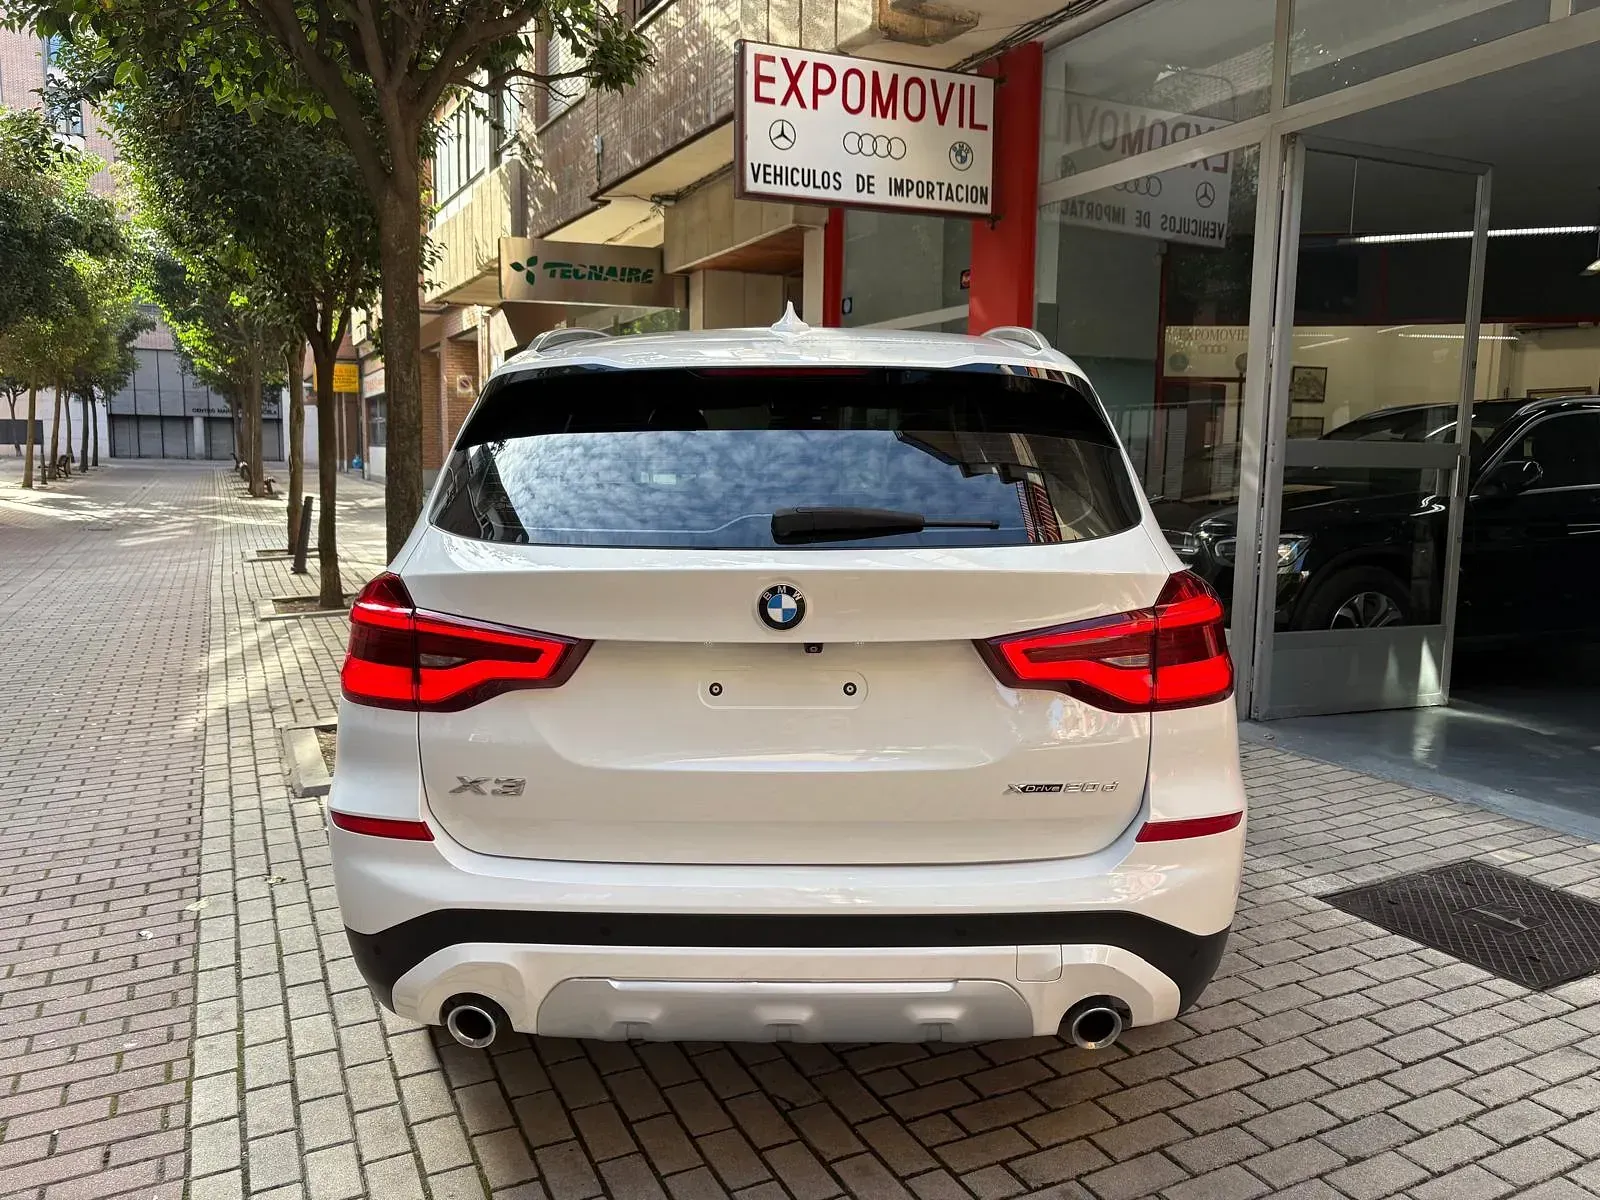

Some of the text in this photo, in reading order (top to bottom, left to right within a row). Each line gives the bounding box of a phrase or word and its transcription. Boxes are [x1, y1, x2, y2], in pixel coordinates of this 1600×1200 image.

[753, 53, 989, 131] EXPOMOVIL
[750, 162, 989, 205] VEHICULOS DE IMPORTACION
[542, 262, 654, 284] TECNAIRE
[763, 585, 803, 601] BMW
[448, 776, 527, 796] X3
